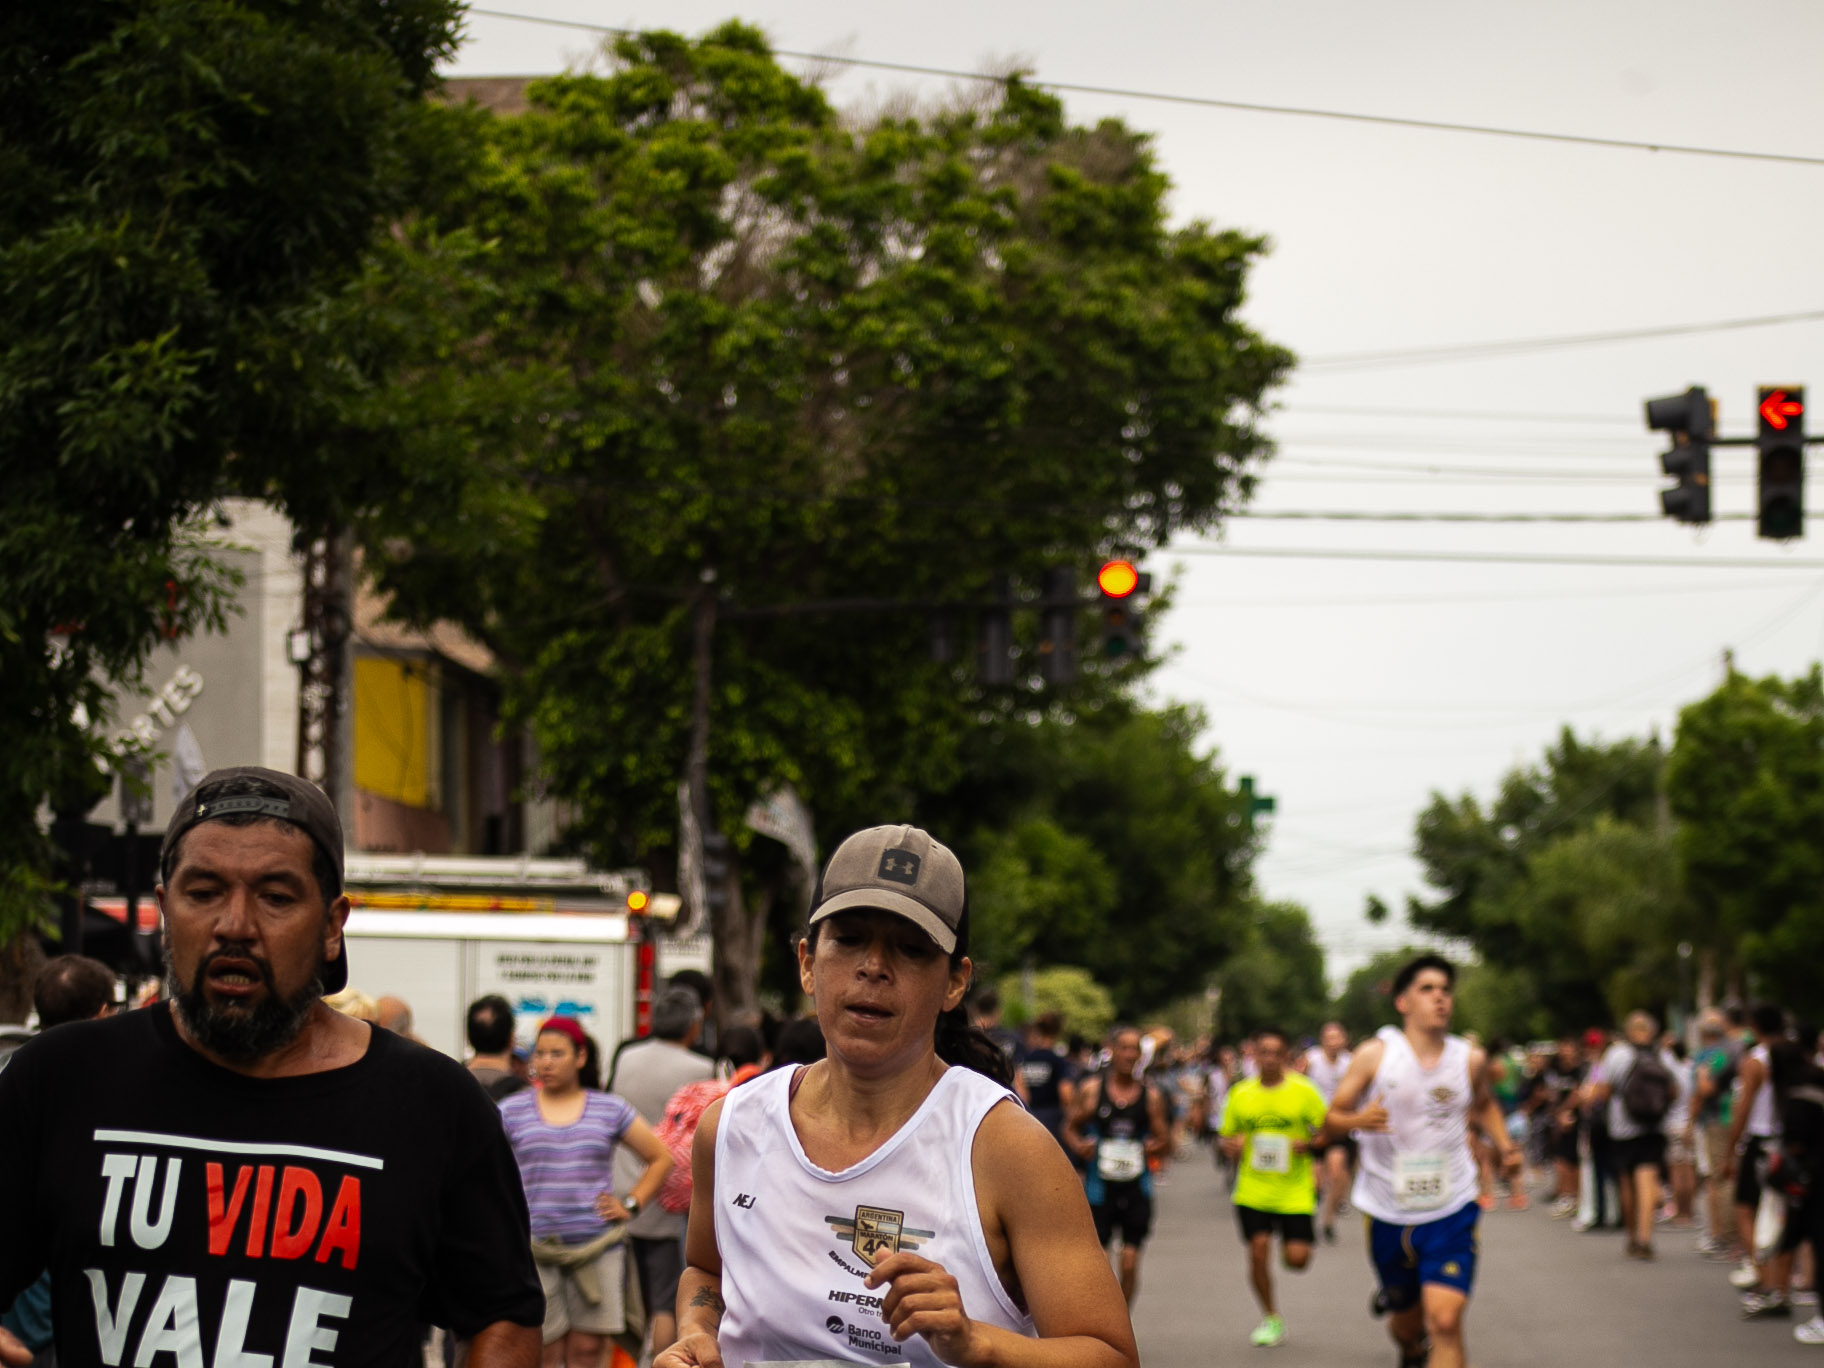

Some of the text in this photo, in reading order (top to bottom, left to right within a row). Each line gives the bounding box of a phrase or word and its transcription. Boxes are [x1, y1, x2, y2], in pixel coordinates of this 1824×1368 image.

[99, 1154, 361, 1270] TU VIDA
[861, 1211, 898, 1223] ARGENTINA
[848, 1324, 881, 1340] Banco
[848, 1336, 902, 1355] Municipal
